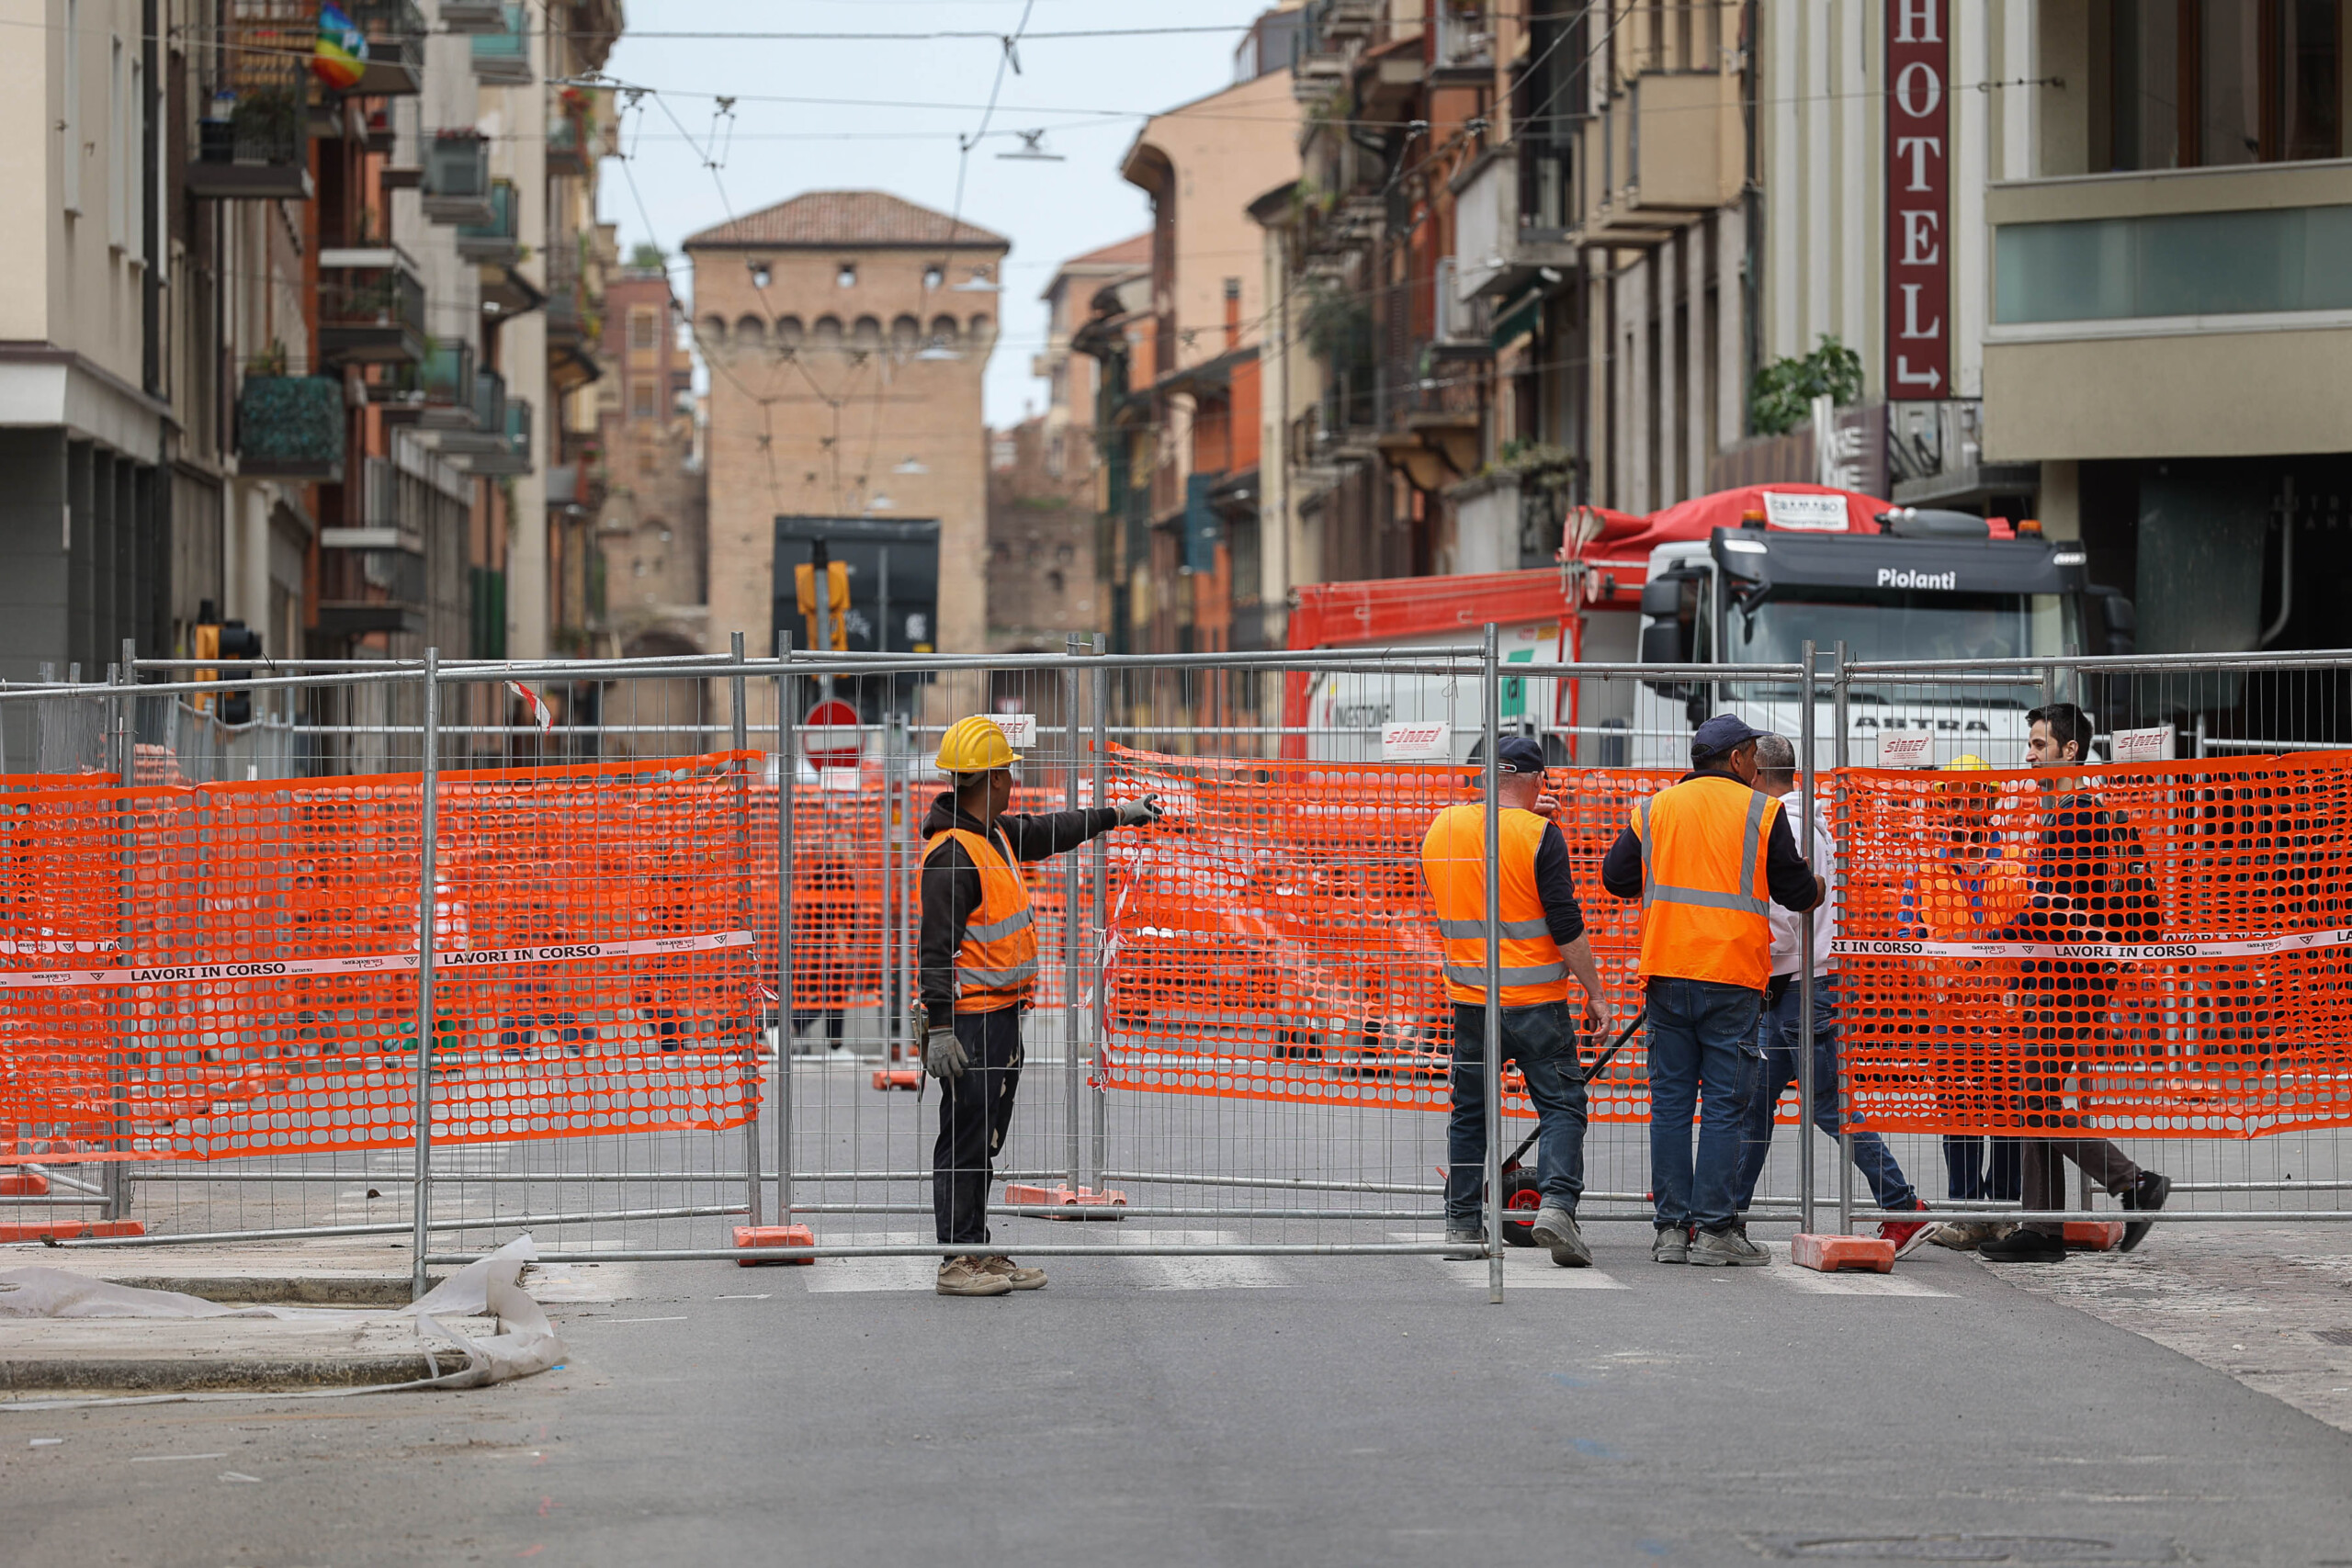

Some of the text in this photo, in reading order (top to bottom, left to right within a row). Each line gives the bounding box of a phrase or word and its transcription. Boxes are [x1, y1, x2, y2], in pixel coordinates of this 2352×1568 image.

[1894, 0, 1942, 340] HOTEL
[1877, 568, 1956, 590] Piolanti
[1855, 716, 1989, 732] ASTRA
[444, 950, 508, 965] LAVORI
[514, 948, 534, 961] IN
[538, 944, 600, 959] CORSO
[1851, 942, 1869, 953] IN
[1873, 942, 1923, 953] CORSO
[2054, 945, 2112, 957] LAVORI
[2118, 946, 2138, 957] IN
[2143, 944, 2197, 957] CORSO
[130, 965, 195, 981] LAVORI
[200, 965, 220, 978] IN
[226, 963, 286, 976] CORSO
